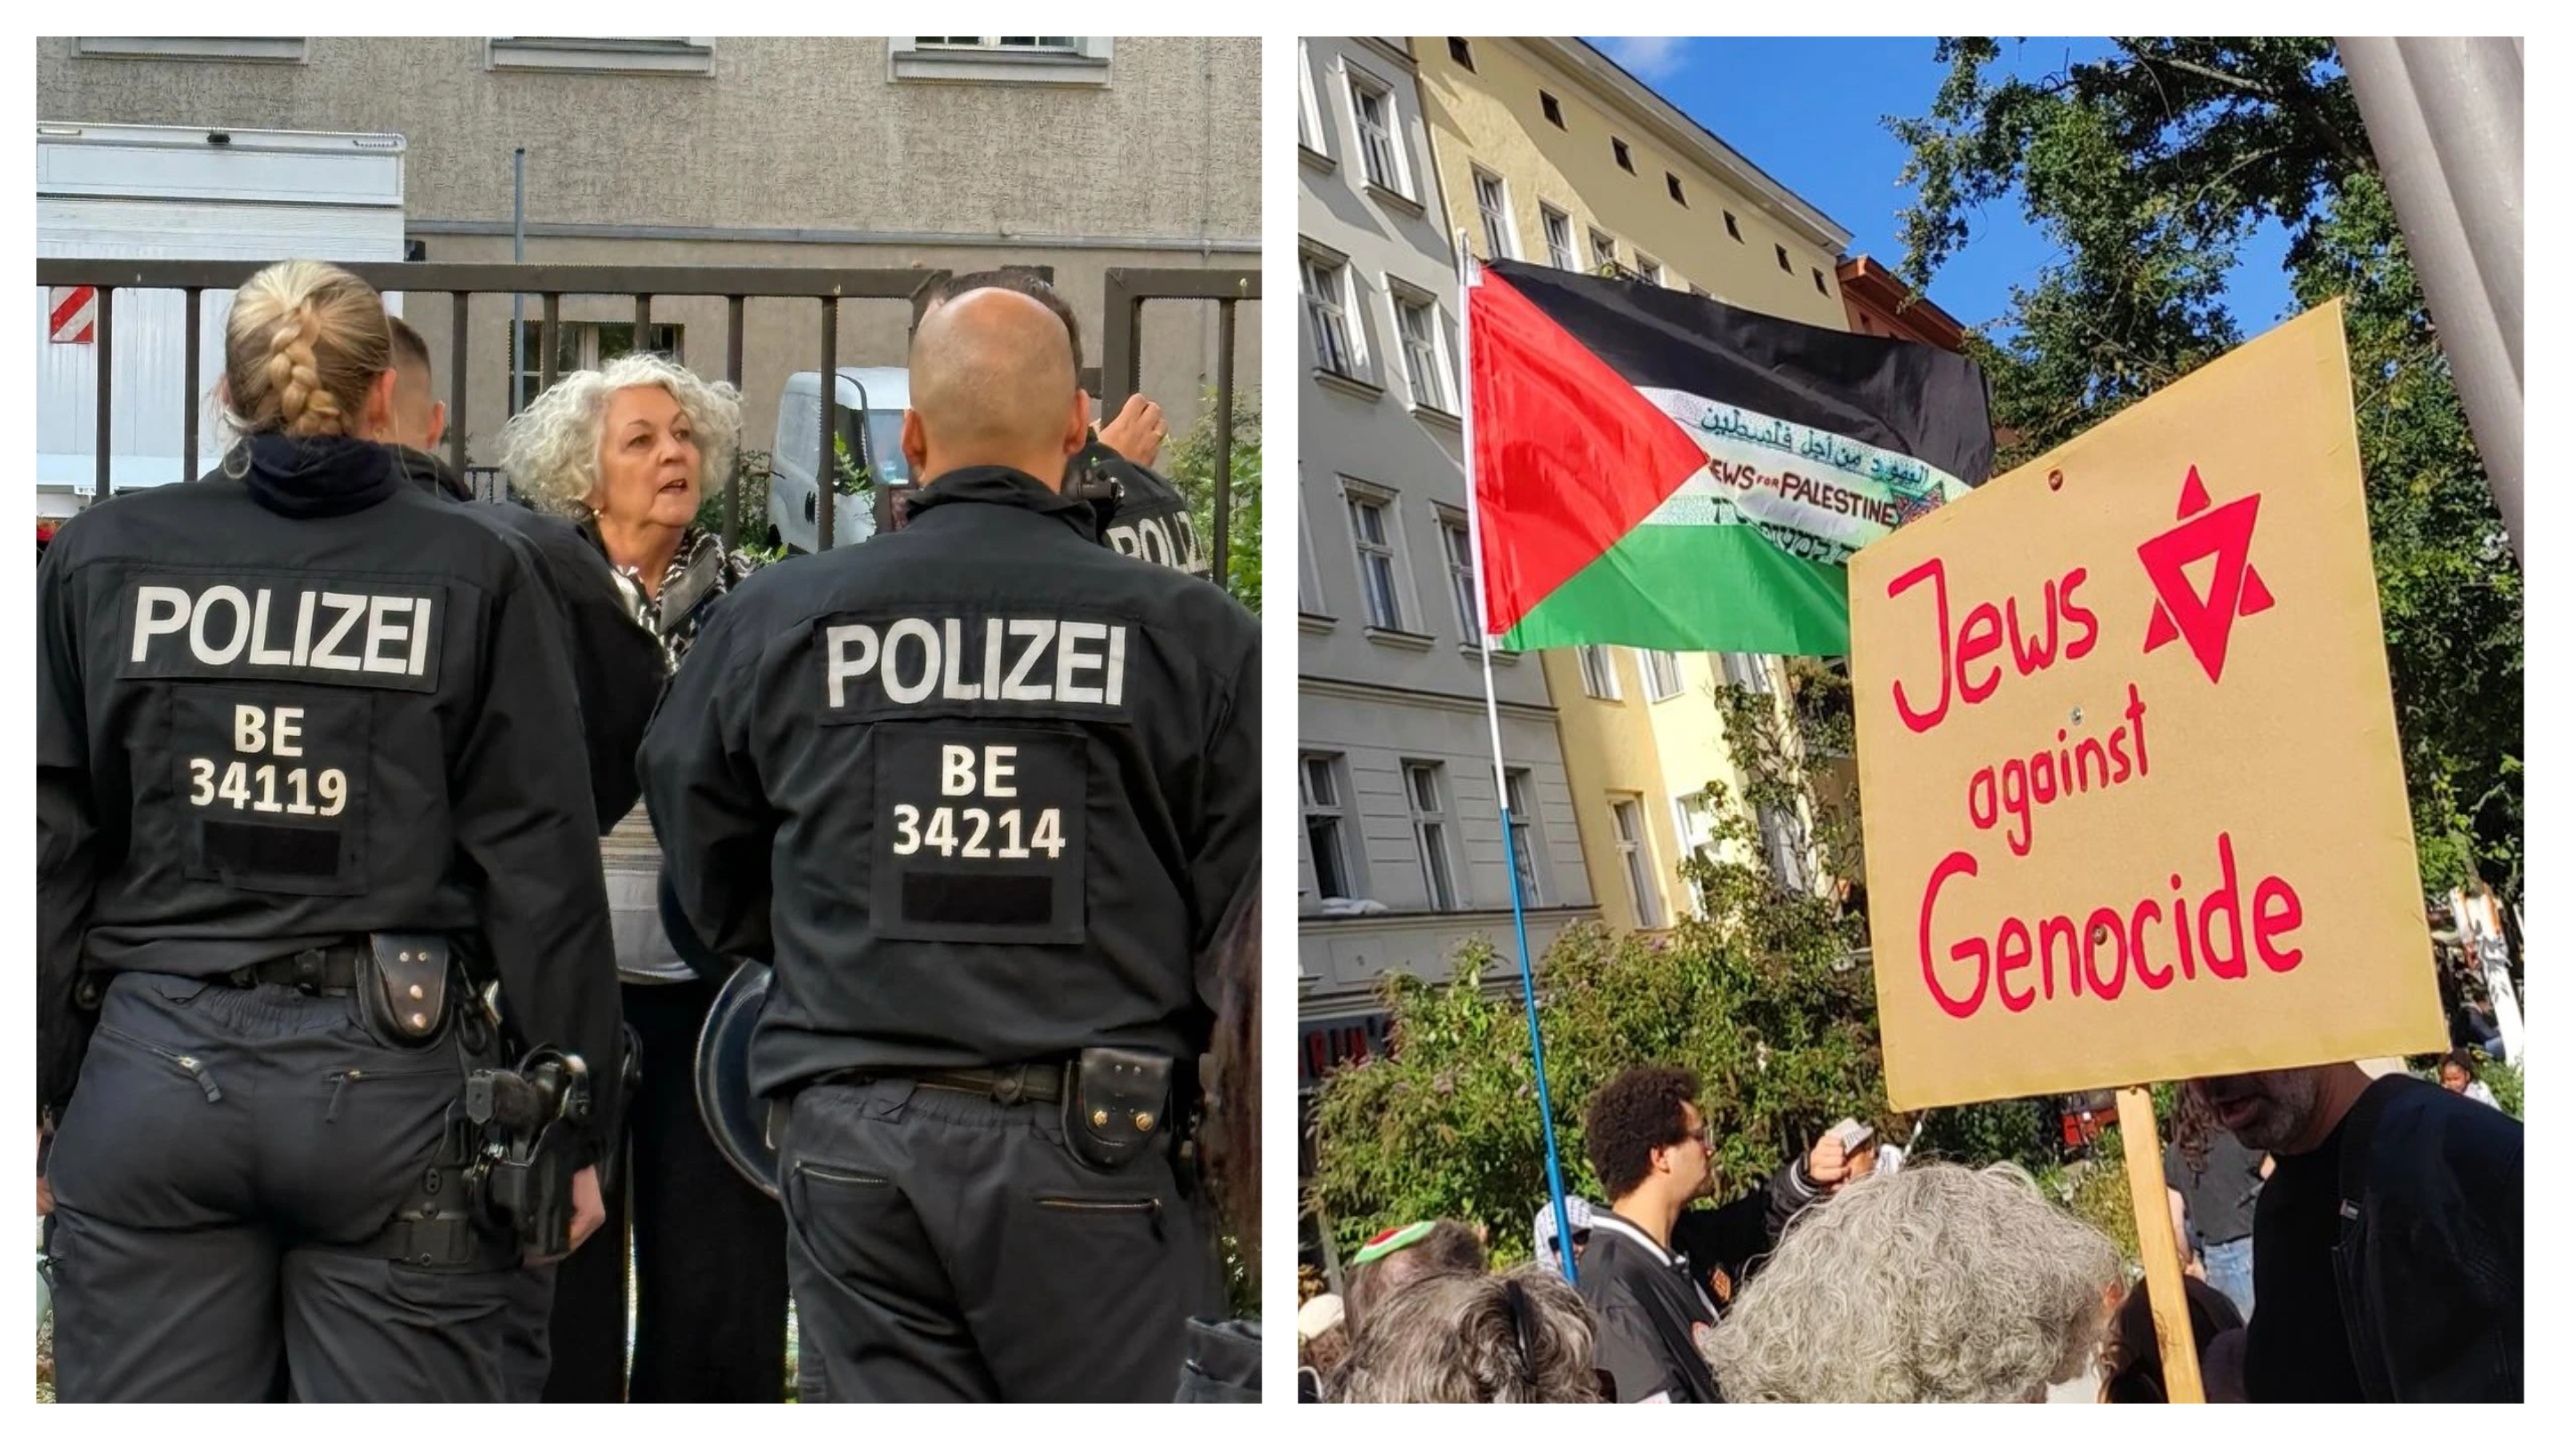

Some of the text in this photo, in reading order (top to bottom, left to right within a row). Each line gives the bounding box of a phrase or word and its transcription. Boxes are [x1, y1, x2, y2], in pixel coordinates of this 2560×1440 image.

[1701, 406, 1793, 448] فلسطين
[1708, 457, 1756, 491] EWS
[1756, 474, 1780, 490] FOR
[1779, 471, 1899, 528] PALESTINE
[131, 585, 432, 676] POLIZEI
[826, 618, 1126, 708] POLIZEI
[1888, 557, 2099, 733] Jews
[235, 704, 304, 757] BE
[189, 758, 347, 816] 34119
[941, 744, 1018, 797] BE
[1968, 682, 2148, 856] against
[893, 803, 1066, 858] 34214
[1919, 831, 2303, 1018] Genocide
